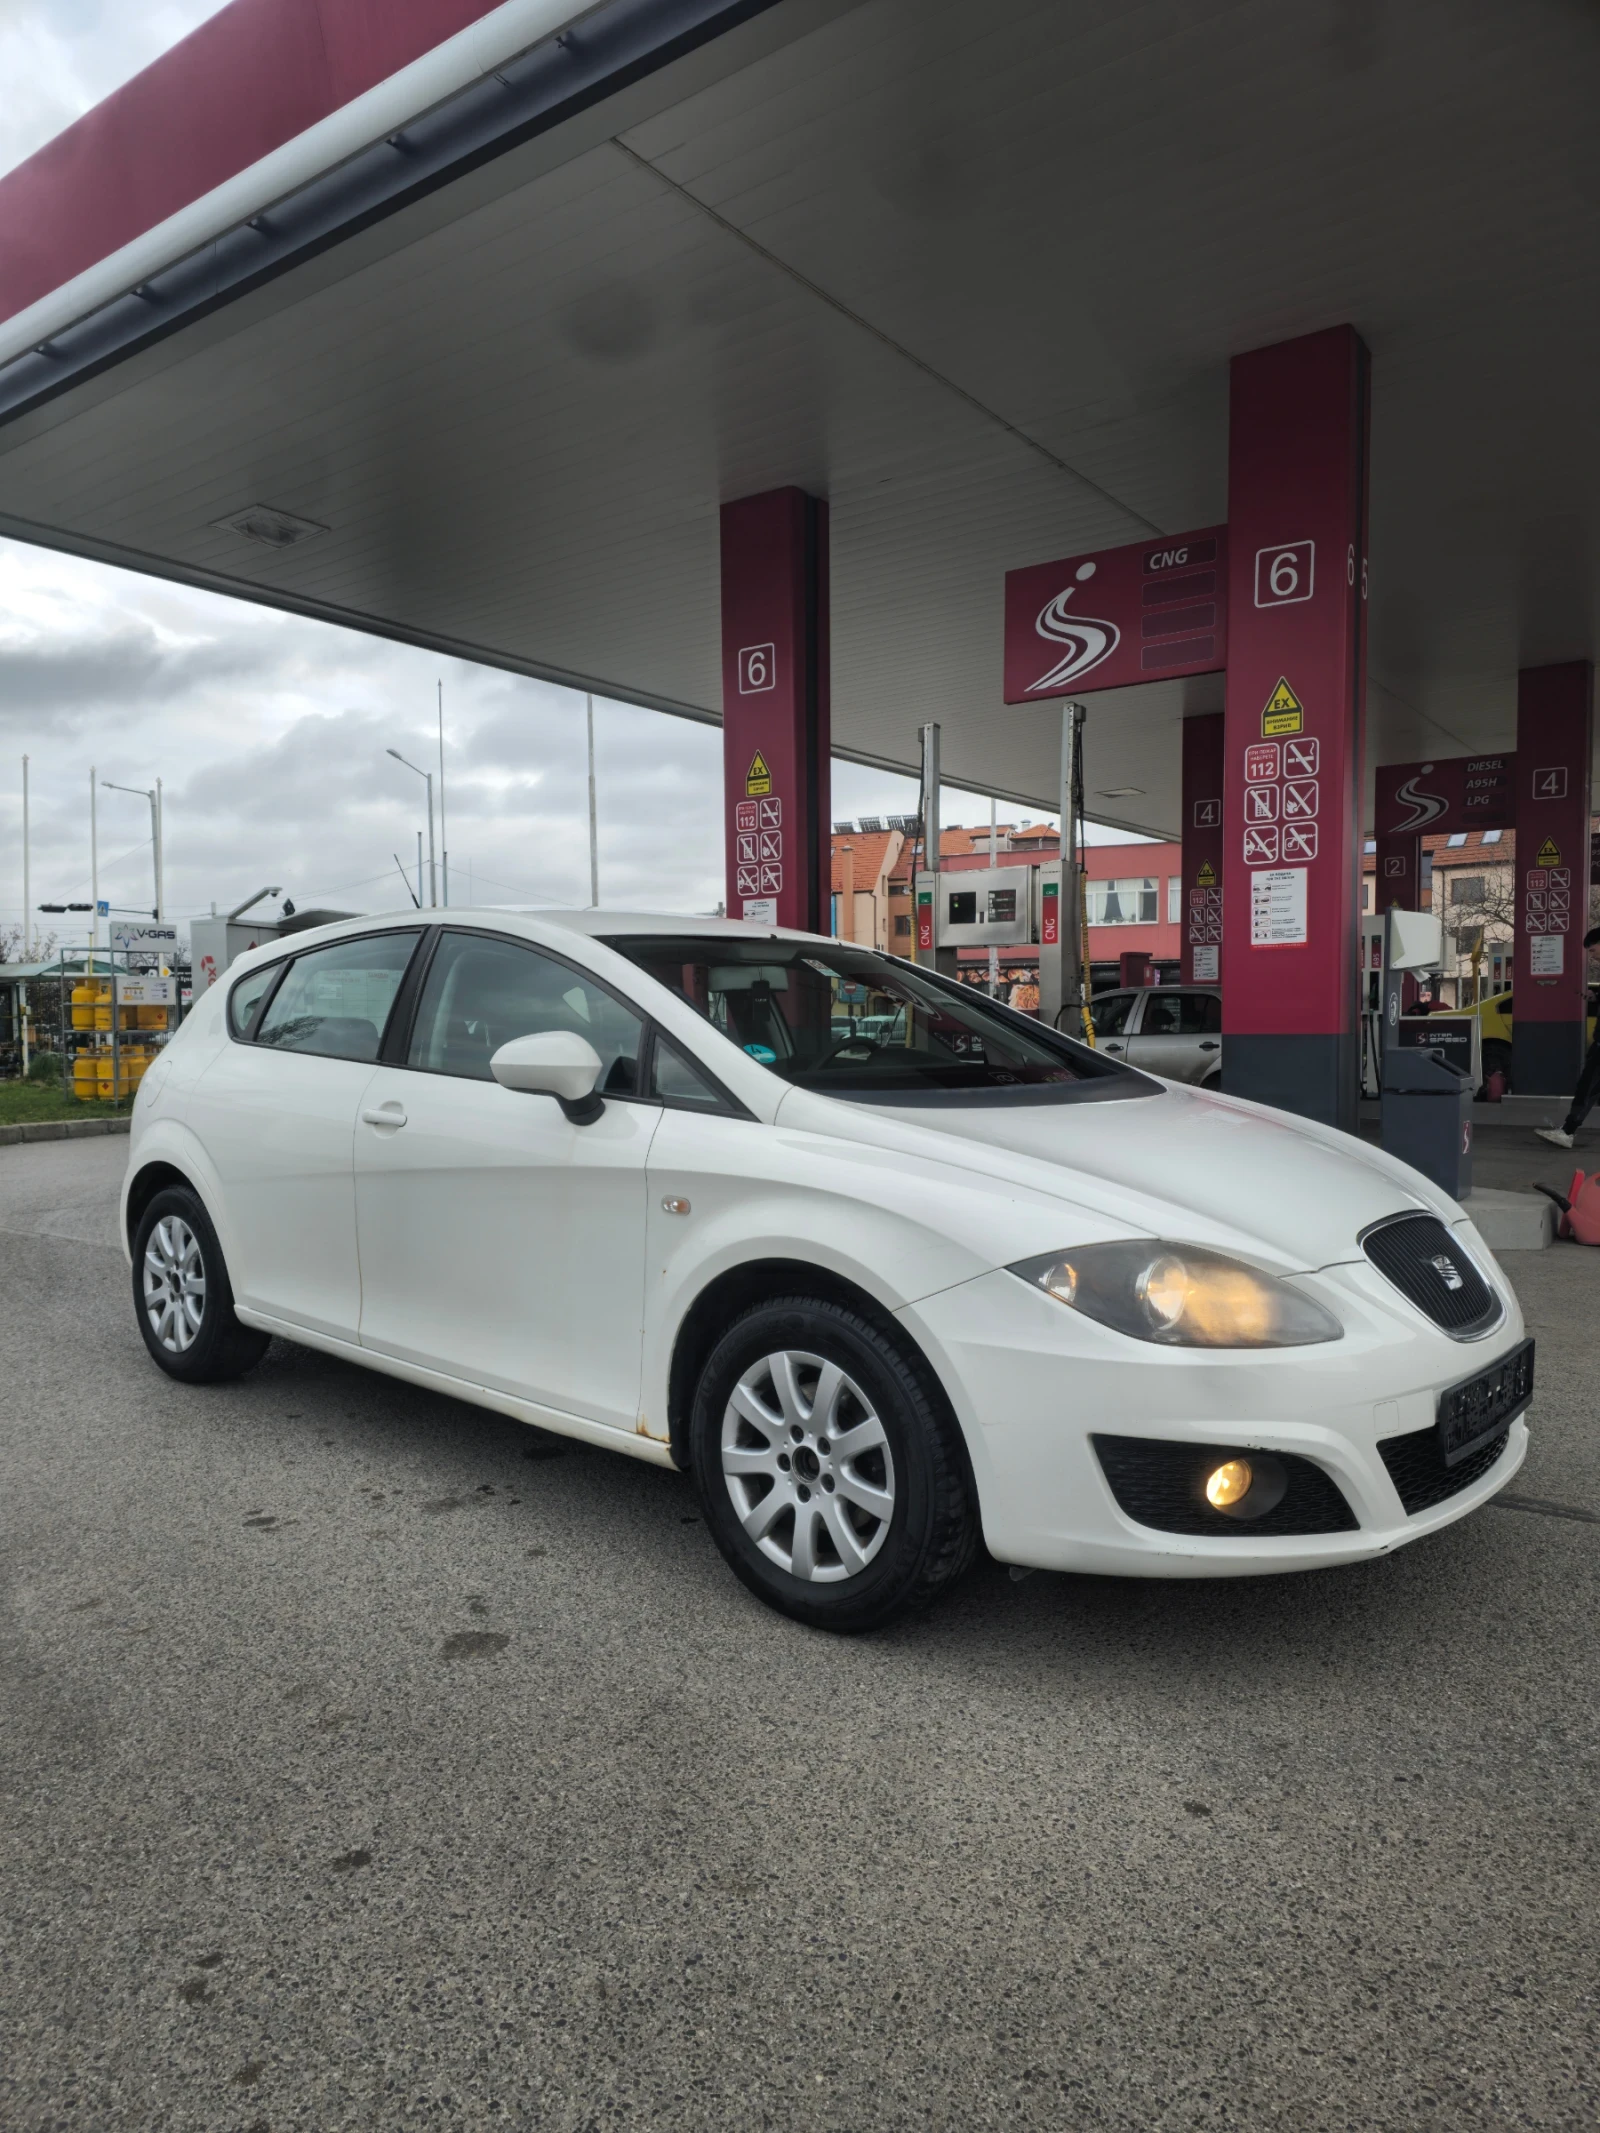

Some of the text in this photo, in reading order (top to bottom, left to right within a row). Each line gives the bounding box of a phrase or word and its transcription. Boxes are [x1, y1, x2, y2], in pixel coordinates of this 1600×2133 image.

[1149, 547, 1189, 570] CNG
[1270, 552, 1298, 596] 6
[748, 651, 766, 686] 6
[1274, 697, 1290, 710] EX
[1266, 715, 1299, 725] ВНИМАНИЕ
[753, 766, 764, 776] EX
[1250, 761, 1275, 777] 112
[1467, 760, 1504, 773] DIESEL
[1465, 777, 1498, 790] A95H
[1541, 772, 1558, 795] 4
[1467, 795, 1490, 807] LPG
[1200, 803, 1214, 823] 4
[739, 815, 755, 828] 112
[1390, 859, 1401, 875] 2
[1530, 879, 1545, 888] 112
[137, 928, 176, 940] V-GAS
[920, 925, 930, 946] CNG
[1045, 918, 1056, 940] CNG
